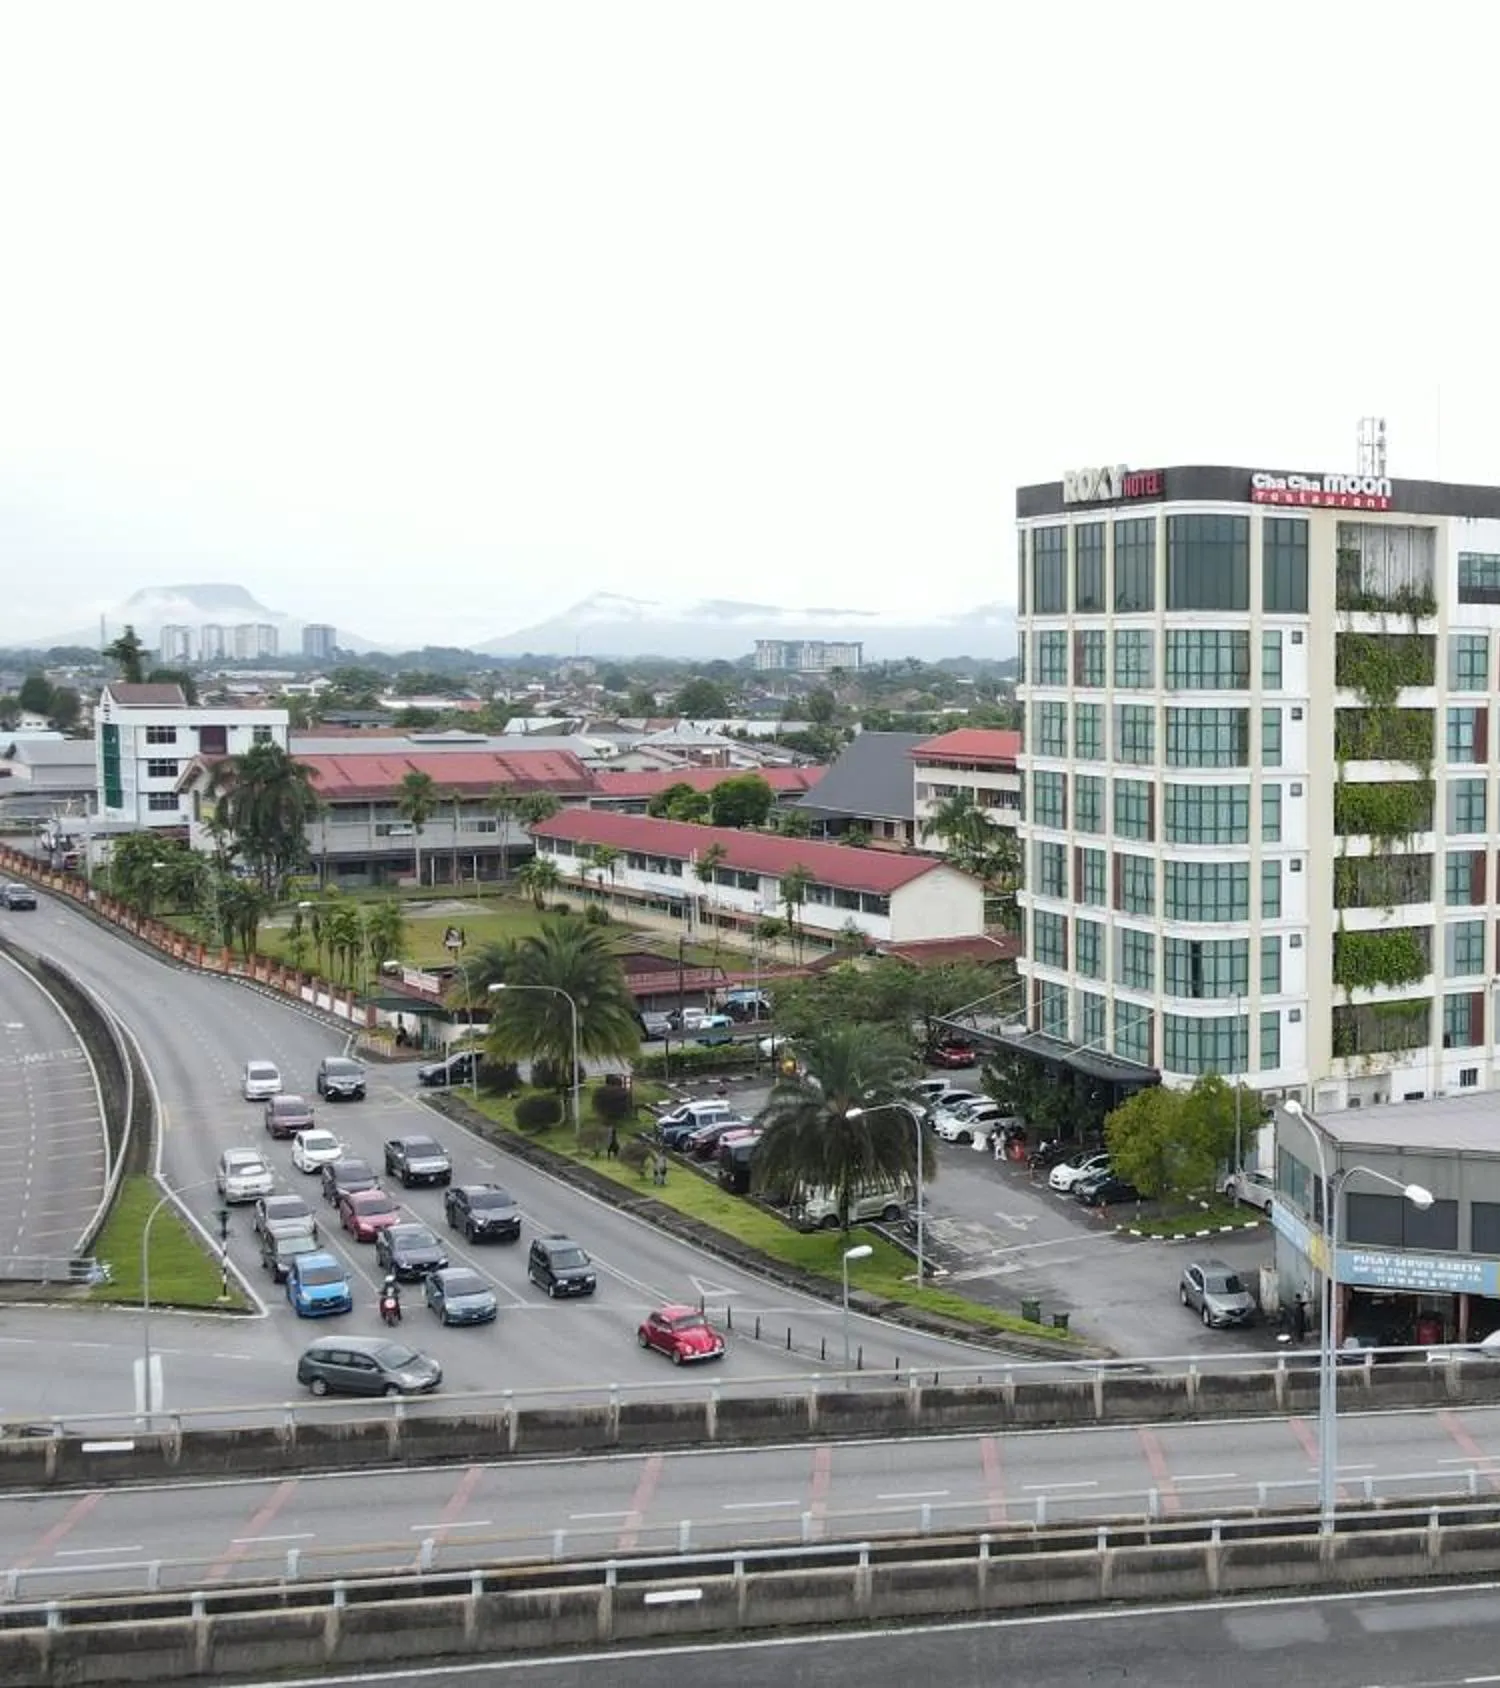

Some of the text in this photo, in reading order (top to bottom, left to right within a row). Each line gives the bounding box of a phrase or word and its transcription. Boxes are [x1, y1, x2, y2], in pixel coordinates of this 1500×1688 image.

[1063, 463, 1164, 503] ROXY HOTEL
[1252, 473, 1286, 489] Cha
[1288, 475, 1320, 491] Cha
[1255, 490, 1388, 509] restaurant
